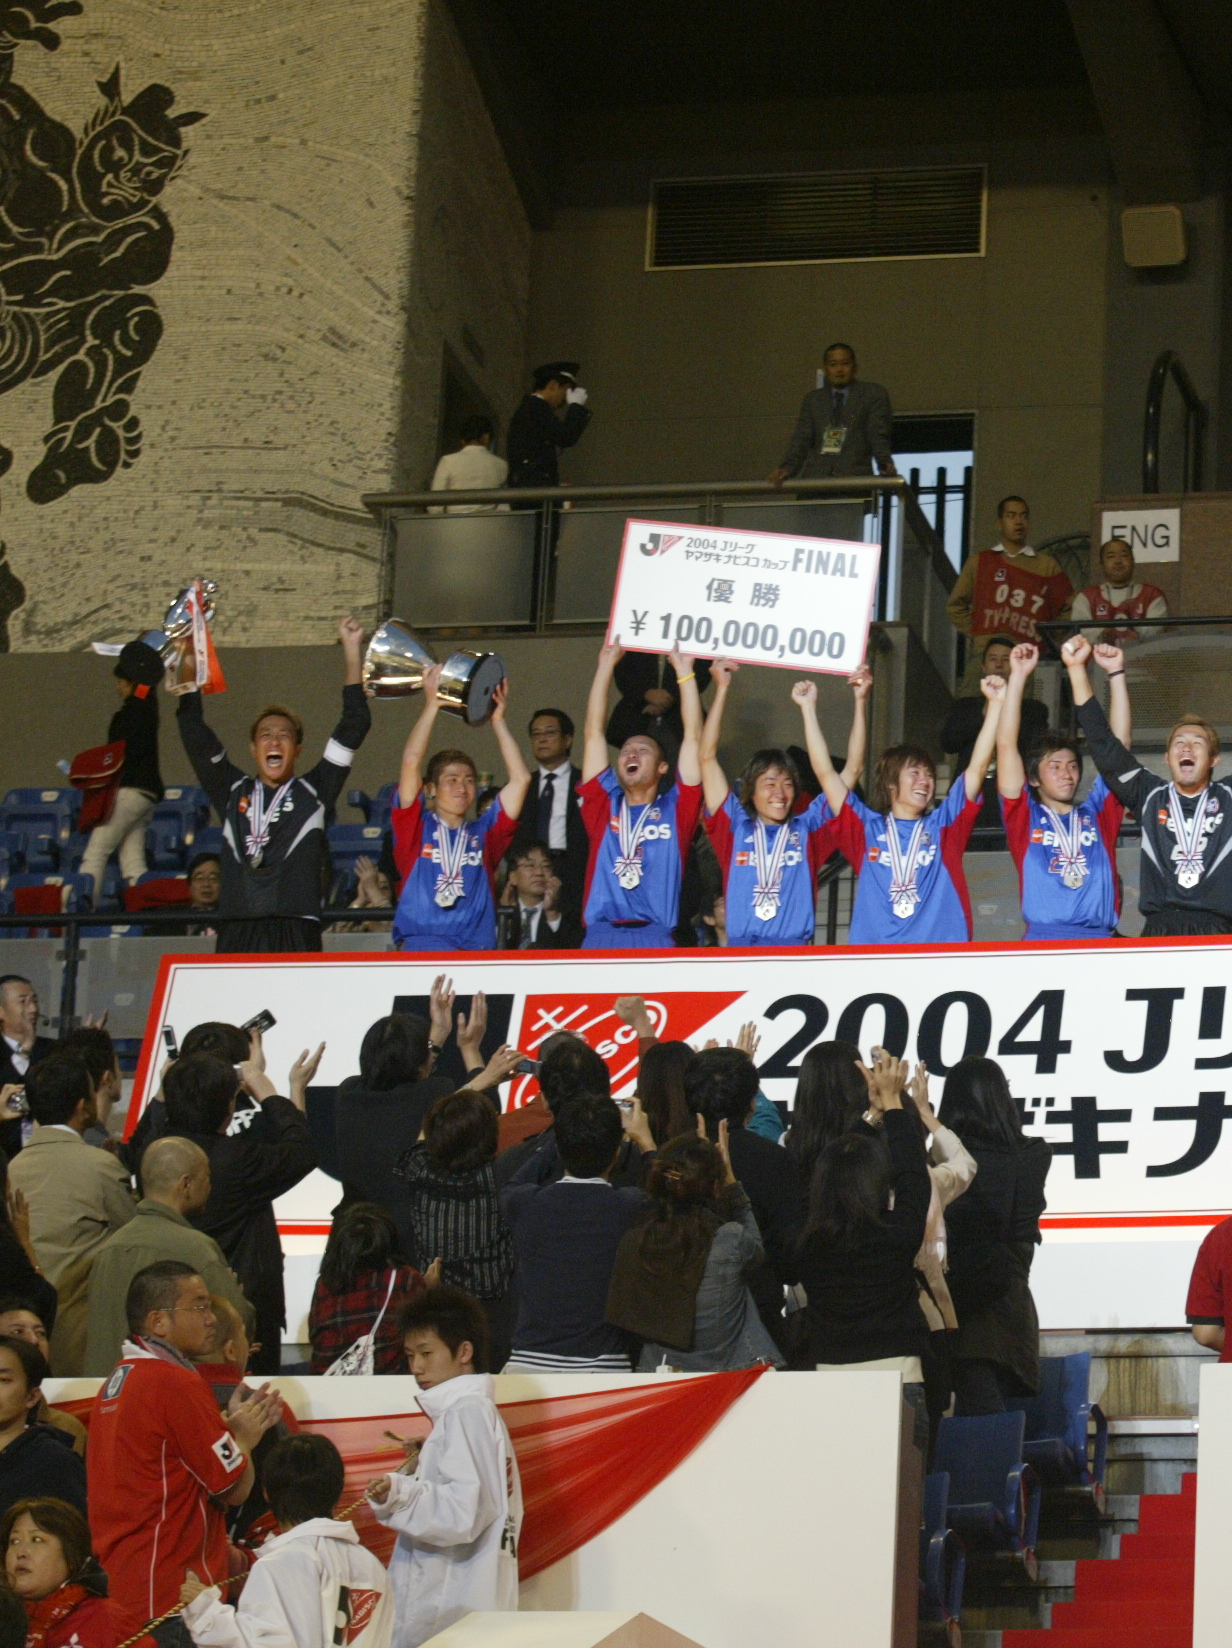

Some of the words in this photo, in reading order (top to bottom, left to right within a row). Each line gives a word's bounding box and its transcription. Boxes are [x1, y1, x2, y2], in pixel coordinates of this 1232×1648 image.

[686, 537, 717, 550] 2004
[720, 540, 757, 554] Jリーグ
[1111, 524, 1170, 549] ENG
[791, 548, 859, 579] FINAL
[995, 584, 1045, 614] 037
[757, 989, 1073, 1078] 2004
